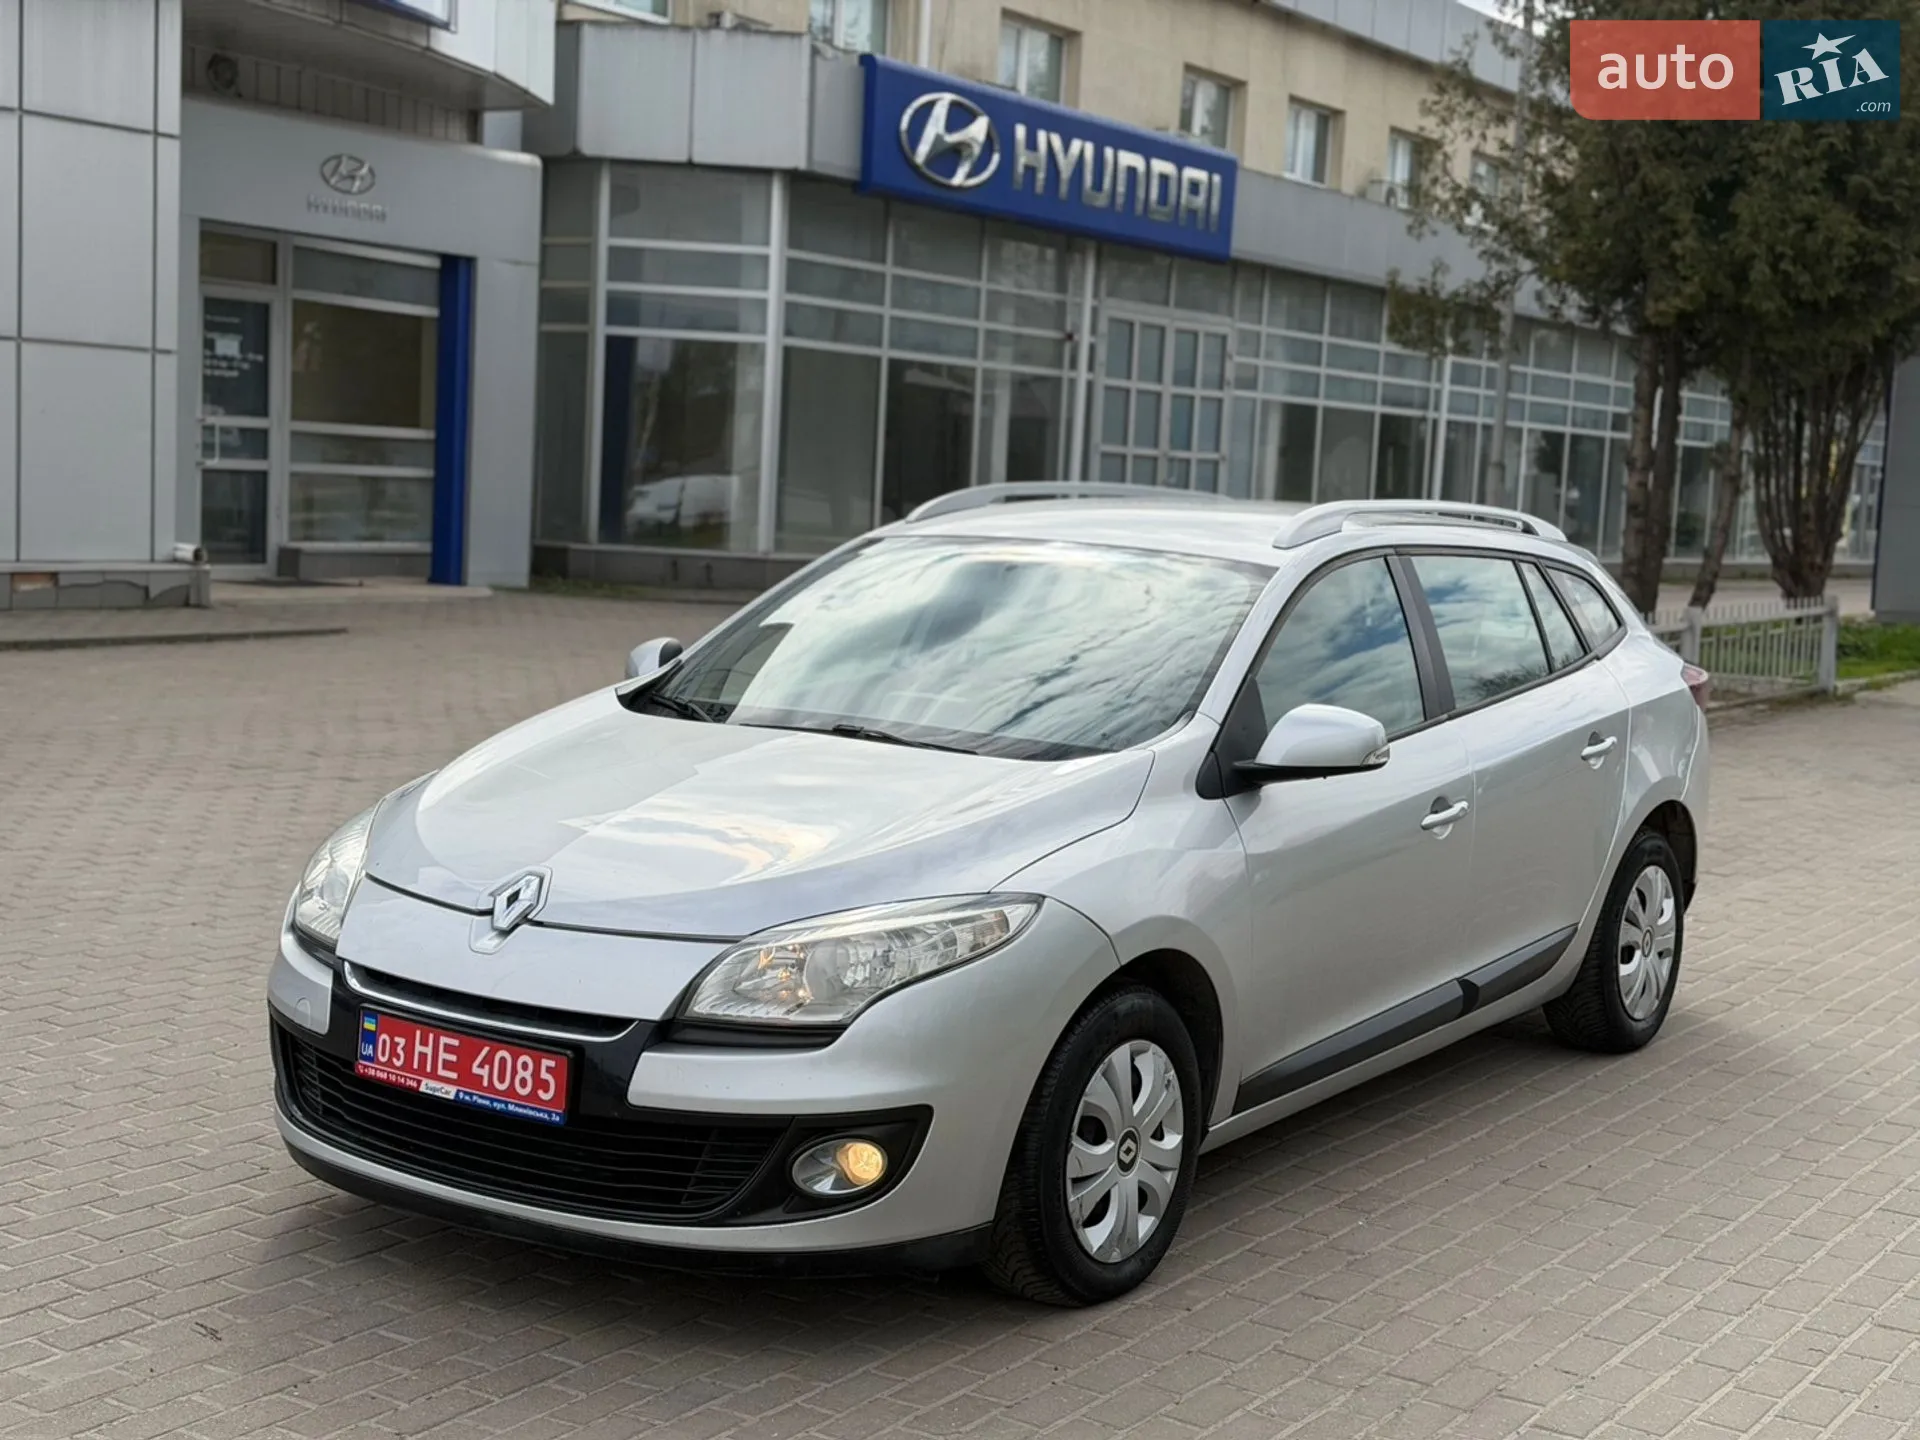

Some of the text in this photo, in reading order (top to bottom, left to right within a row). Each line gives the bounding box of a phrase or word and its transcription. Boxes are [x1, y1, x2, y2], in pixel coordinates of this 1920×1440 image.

[1013, 123, 1221, 233] HYUNDAI
[361, 1043, 373, 1058] UA
[377, 1030, 556, 1101] 03 HE 4085
